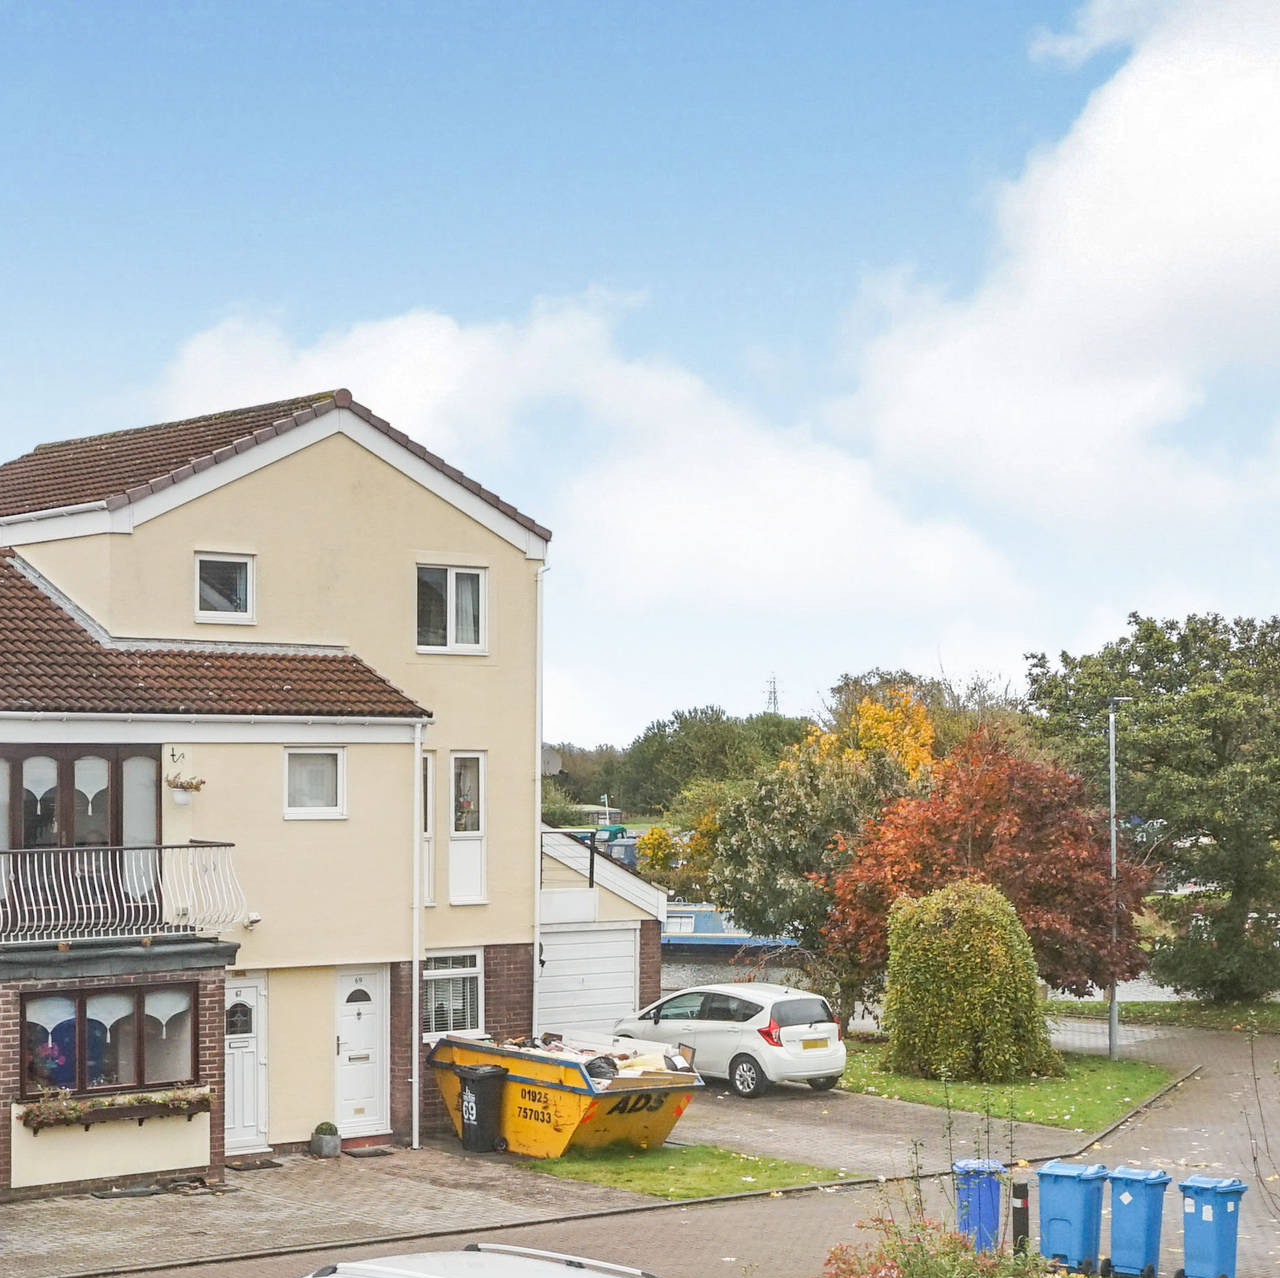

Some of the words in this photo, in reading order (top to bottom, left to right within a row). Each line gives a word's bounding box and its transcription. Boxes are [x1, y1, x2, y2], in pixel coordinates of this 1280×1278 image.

[521, 1088, 549, 1105] 01925
[606, 1092, 670, 1116] ADS
[463, 1101, 477, 1121] 69
[517, 1105, 552, 1124] 757033
